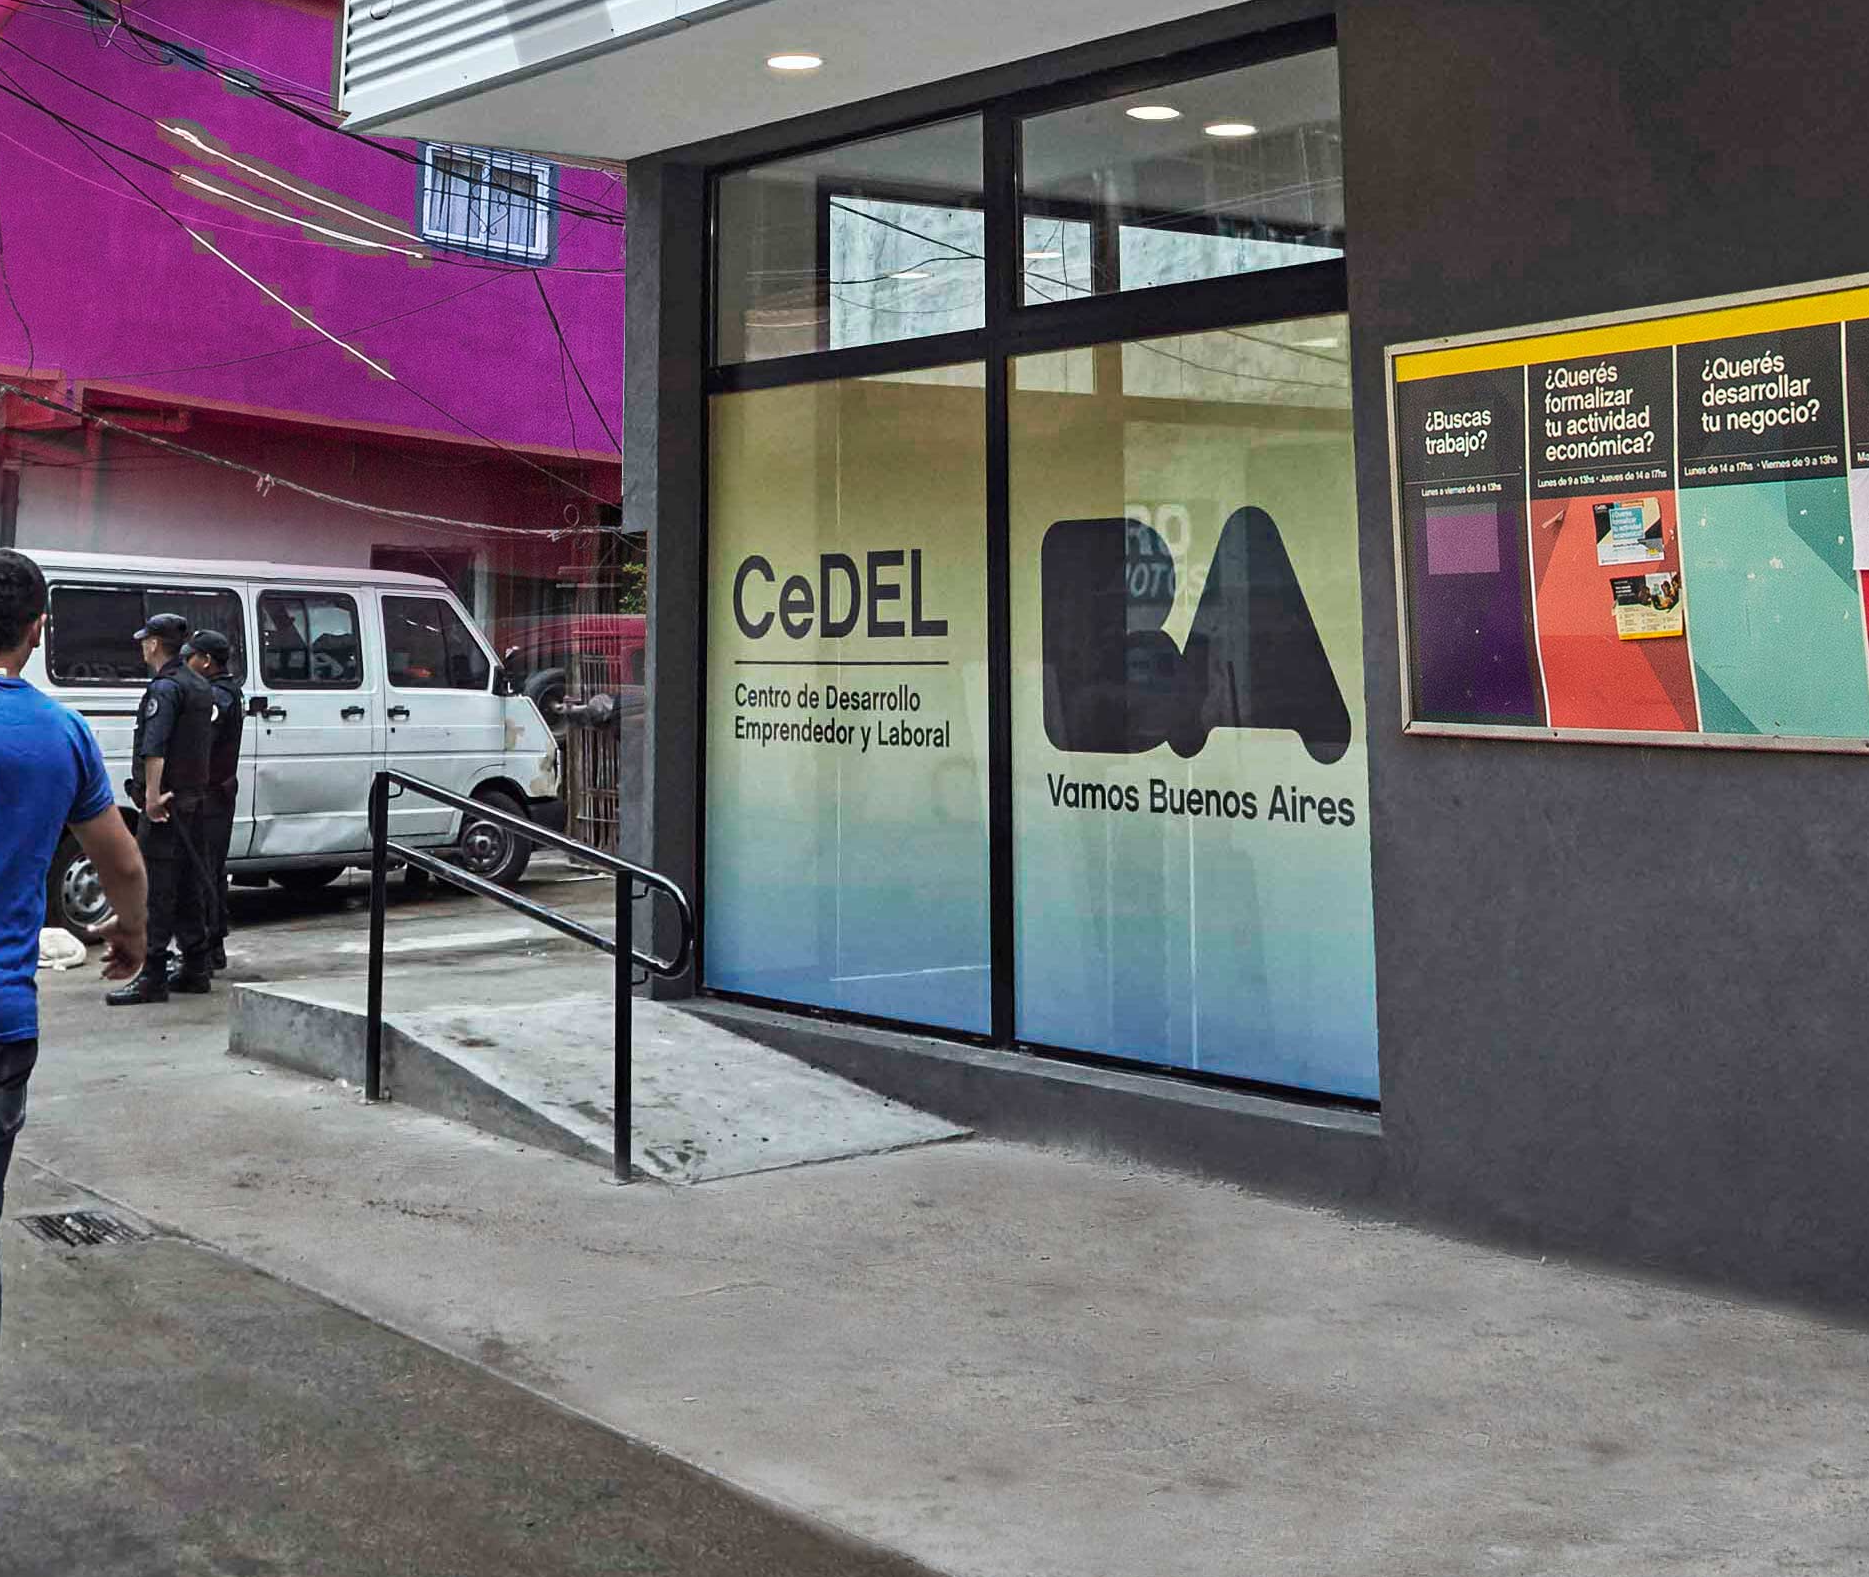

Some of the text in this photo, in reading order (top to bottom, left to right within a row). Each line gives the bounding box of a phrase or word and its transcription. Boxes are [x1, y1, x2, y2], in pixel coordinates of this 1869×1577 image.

[1545, 361, 1618, 390] ¿Querés
[1701, 350, 1785, 382] ¿Querés
[1545, 386, 1634, 414] formalizar
[1701, 374, 1812, 407] desarrollar
[1425, 409, 1492, 433] ¿Buscas
[1545, 405, 1651, 438] tu actividad
[1701, 398, 1821, 435] tu negocio?
[1425, 429, 1488, 458] trabajo?
[1545, 430, 1656, 462] económica?
[1537, 478, 1557, 488] Lunes
[1558, 476, 1567, 486] de
[1625, 471, 1635, 481] de
[1635, 470, 1644, 480] 14
[1684, 466, 1707, 476] Lunes
[1708, 464, 1718, 474] de
[1719, 463, 1729, 473] 14
[1729, 464, 1735, 472] a
[1761, 459, 1791, 470] Viernes
[1792, 456, 1803, 468] de
[1804, 456, 1811, 467] 9
[1812, 457, 1818, 465] a
[733, 548, 949, 642] CeDEL
[1041, 505, 1352, 765] BA
[734, 682, 921, 712] Centro de Desarrollo
[734, 714, 951, 753] Emprendedor y Laboral
[1046, 773, 1356, 827] Vamos Buenos Aires
